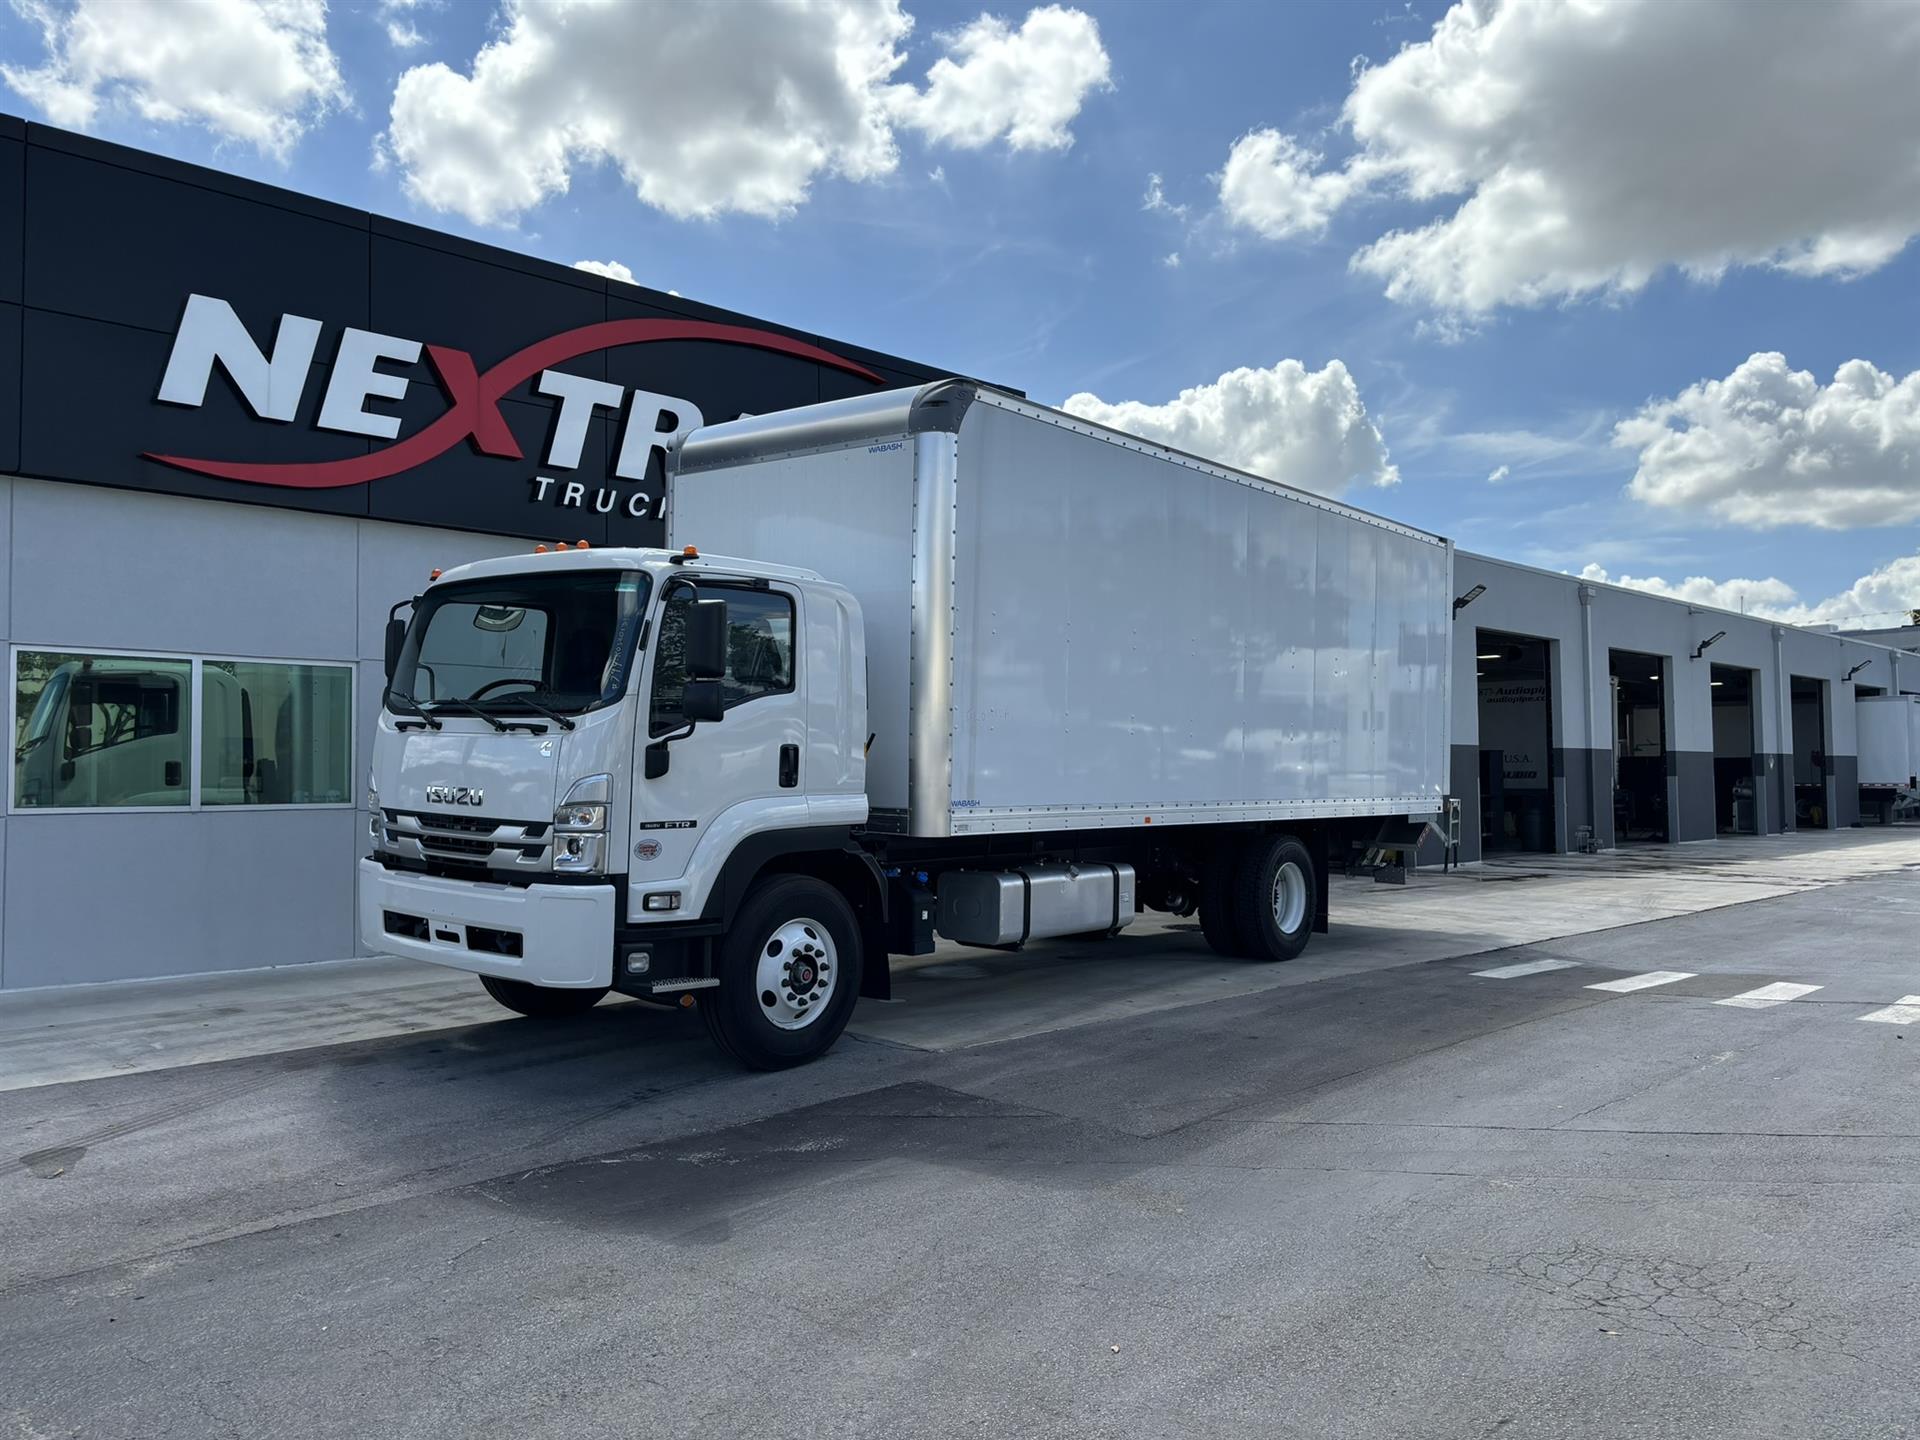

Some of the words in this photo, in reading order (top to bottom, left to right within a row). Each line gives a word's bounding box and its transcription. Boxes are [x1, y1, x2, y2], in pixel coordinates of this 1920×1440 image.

[156, 293, 705, 481] NEXTR
[868, 442, 903, 454] WABASH
[426, 785, 484, 806] ISUZU
[951, 799, 980, 807] WABASH
[664, 821, 691, 829] FTR
